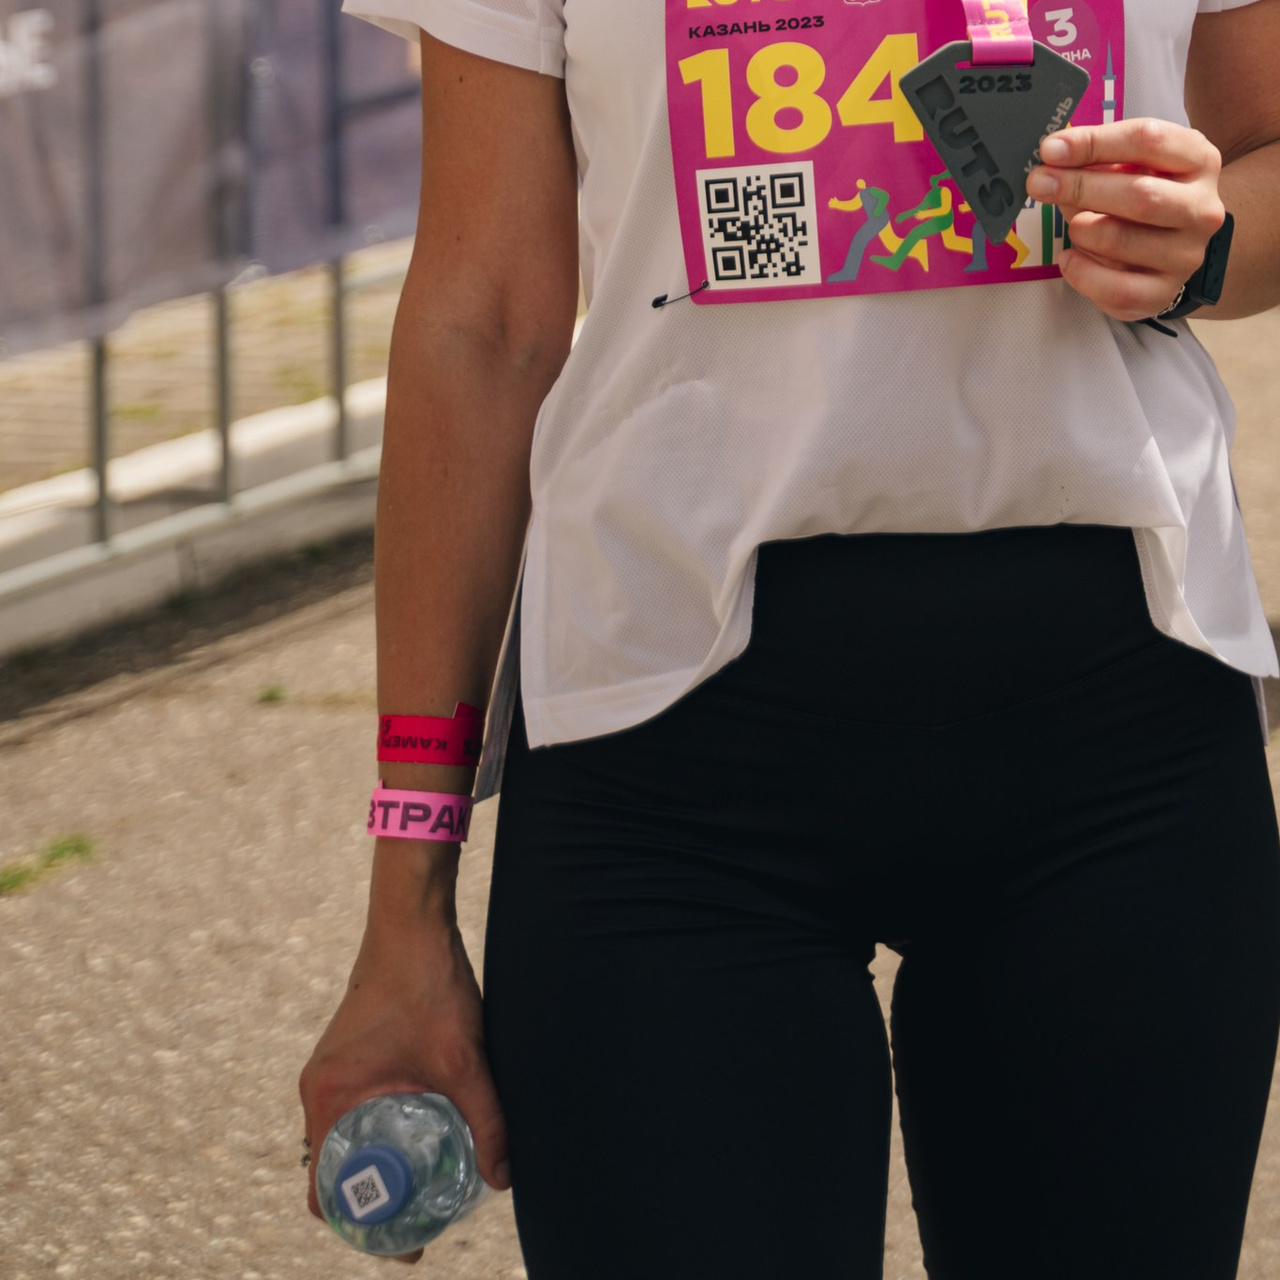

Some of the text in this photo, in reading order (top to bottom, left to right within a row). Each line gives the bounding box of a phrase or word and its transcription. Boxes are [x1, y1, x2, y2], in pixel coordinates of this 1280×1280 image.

[688, 15, 825, 39] КАЗАНЬ 2023
[1045, 8, 1078, 47] 3
[678, 32, 925, 159] 184
[959, 72, 1033, 94] 2023
[915, 74, 1015, 217] RUTS
